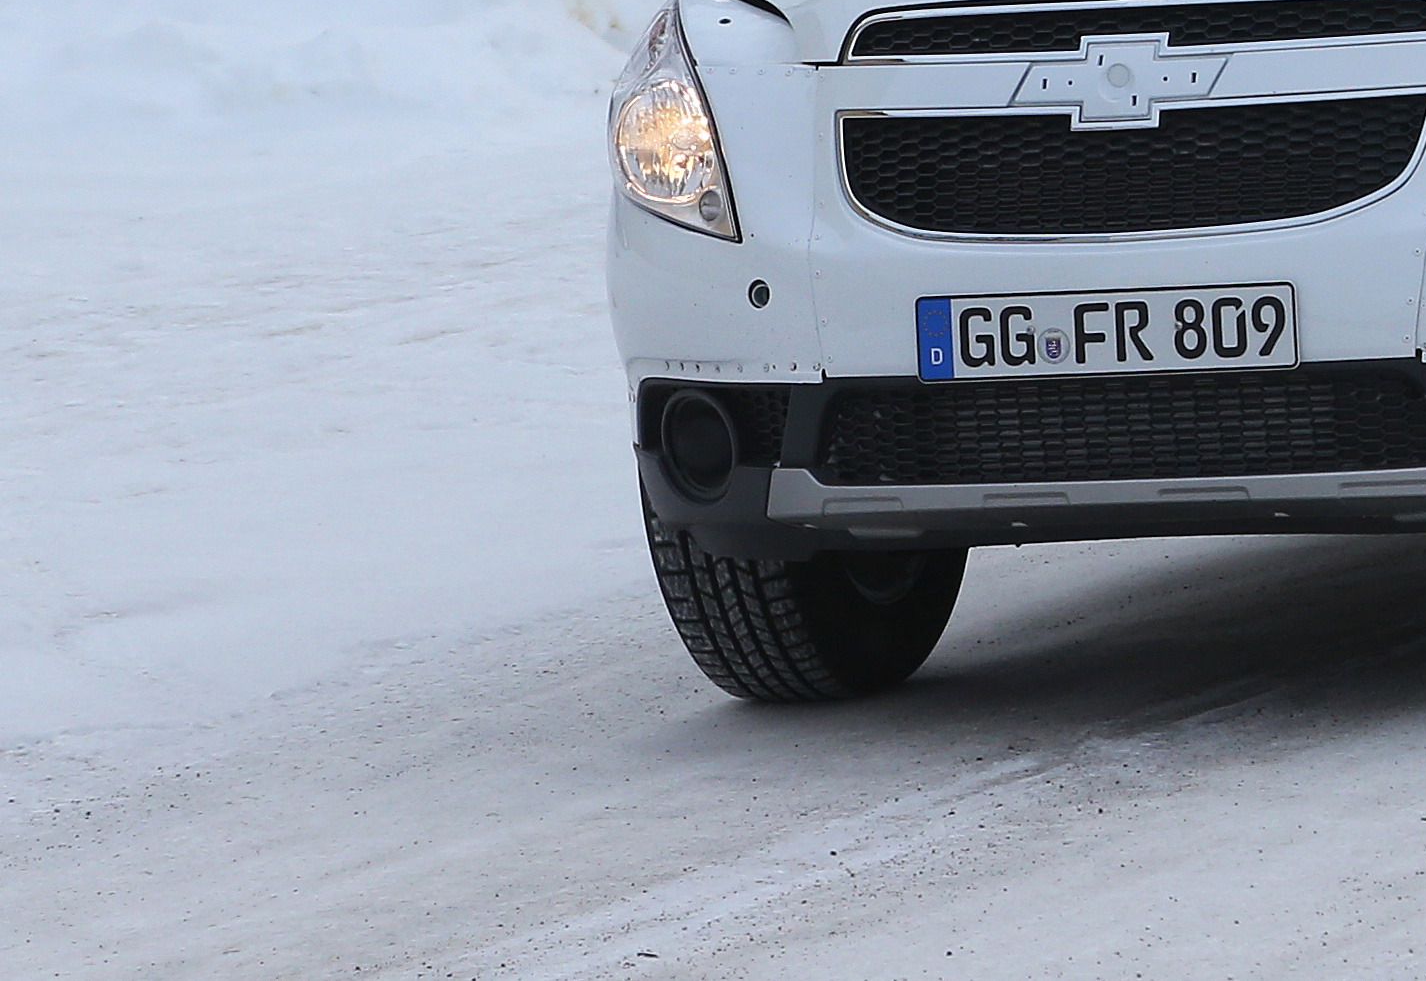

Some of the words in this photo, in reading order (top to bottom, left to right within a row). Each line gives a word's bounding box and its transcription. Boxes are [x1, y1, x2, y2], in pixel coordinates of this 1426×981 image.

[931, 347, 944, 366] D
[957, 305, 1037, 368] GG
[1072, 301, 1155, 365] FR
[1173, 295, 1287, 360] 809
